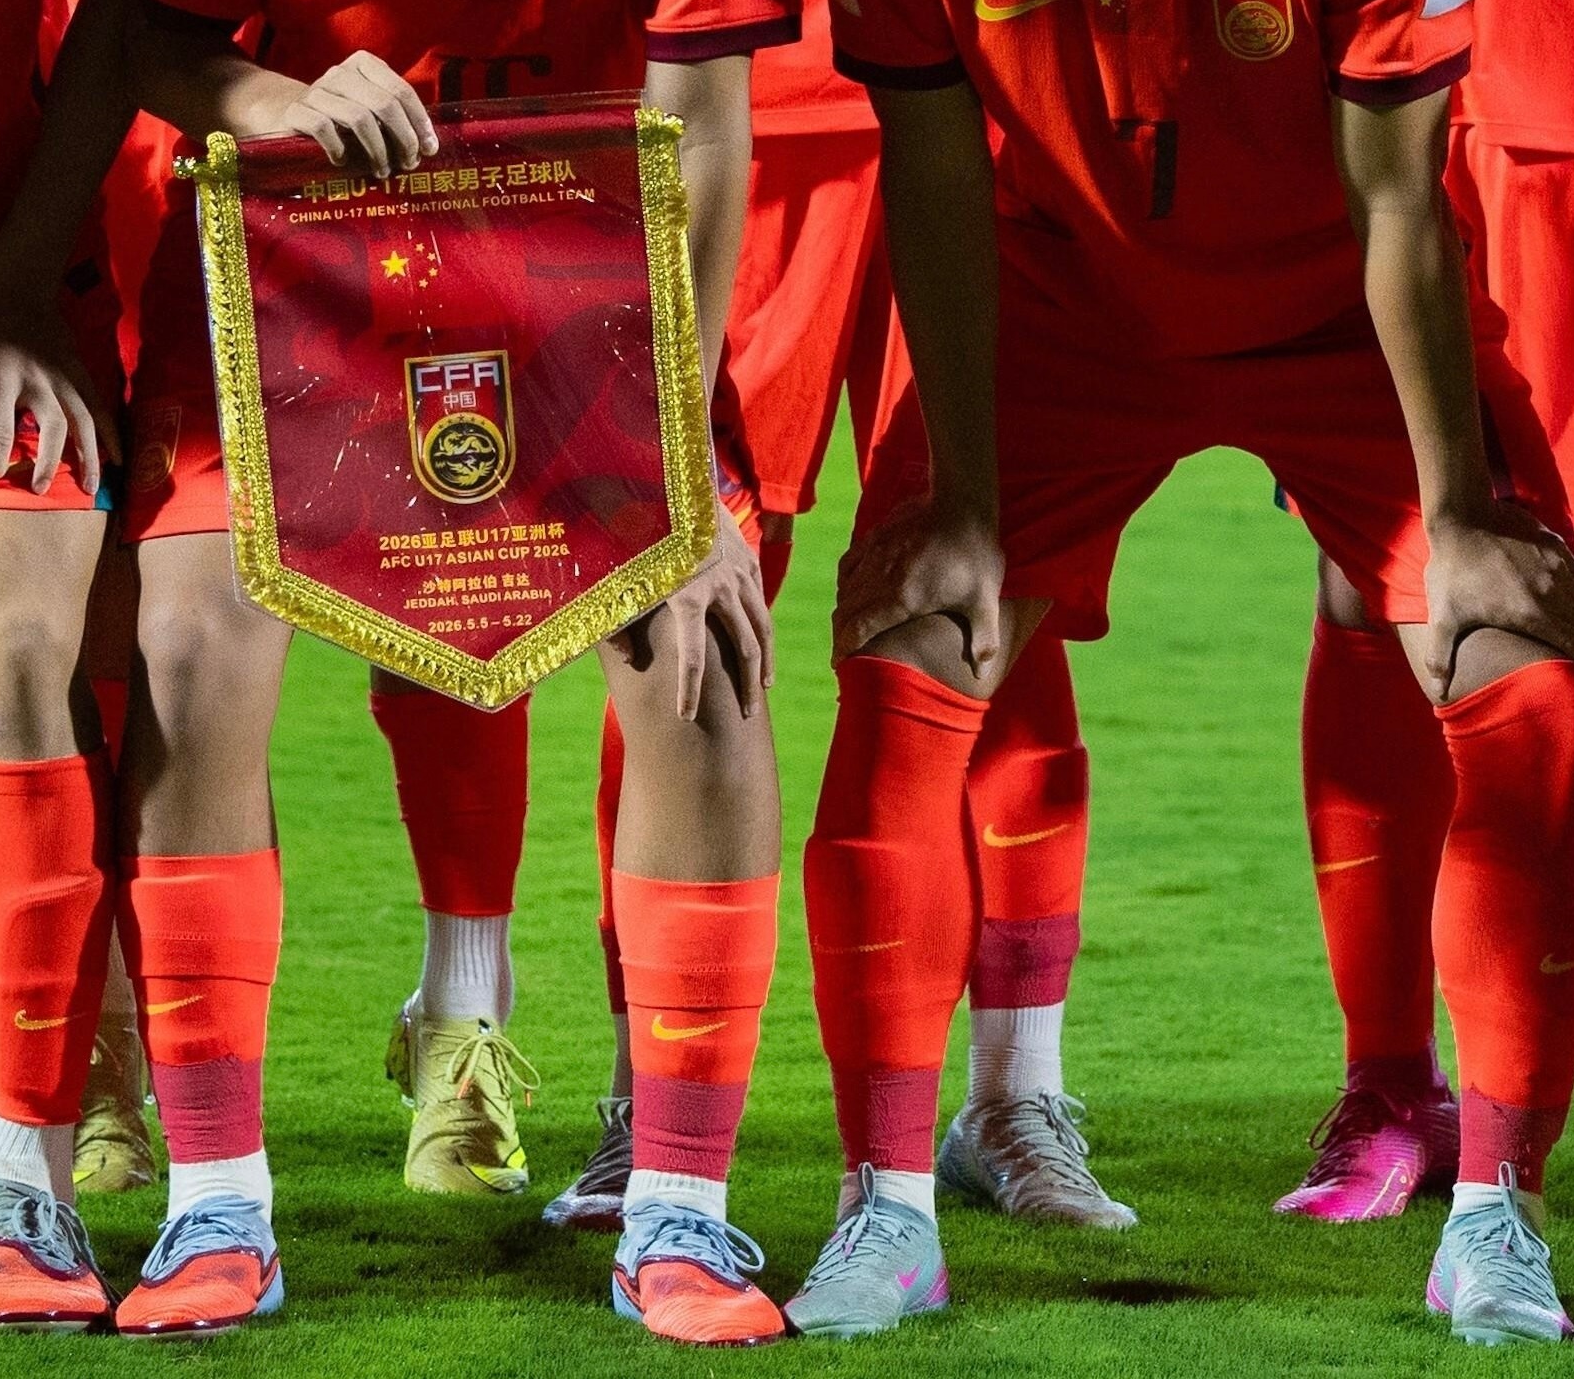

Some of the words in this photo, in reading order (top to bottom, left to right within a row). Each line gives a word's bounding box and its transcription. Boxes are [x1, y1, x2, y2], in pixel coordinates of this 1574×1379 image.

[289, 210, 331, 224] CHINA
[334, 207, 362, 220] U-17
[366, 203, 408, 217] MEN'S
[411, 197, 479, 213] NATIONAL
[483, 191, 555, 207] FOOTBALL
[558, 188, 595, 201] TEAM
[415, 361, 500, 393] CFA
[443, 391, 476, 409] 中国
[379, 523, 565, 551] 2026亚足联U17亚洲杯
[380, 555, 411, 569] AFC
[415, 554, 442, 567] U17
[446, 549, 494, 565] ASIAN
[498, 546, 530, 560] CUP
[534, 543, 569, 558] 2026
[461, 591, 501, 606] SAUDI
[504, 588, 552, 602] ARABIA
